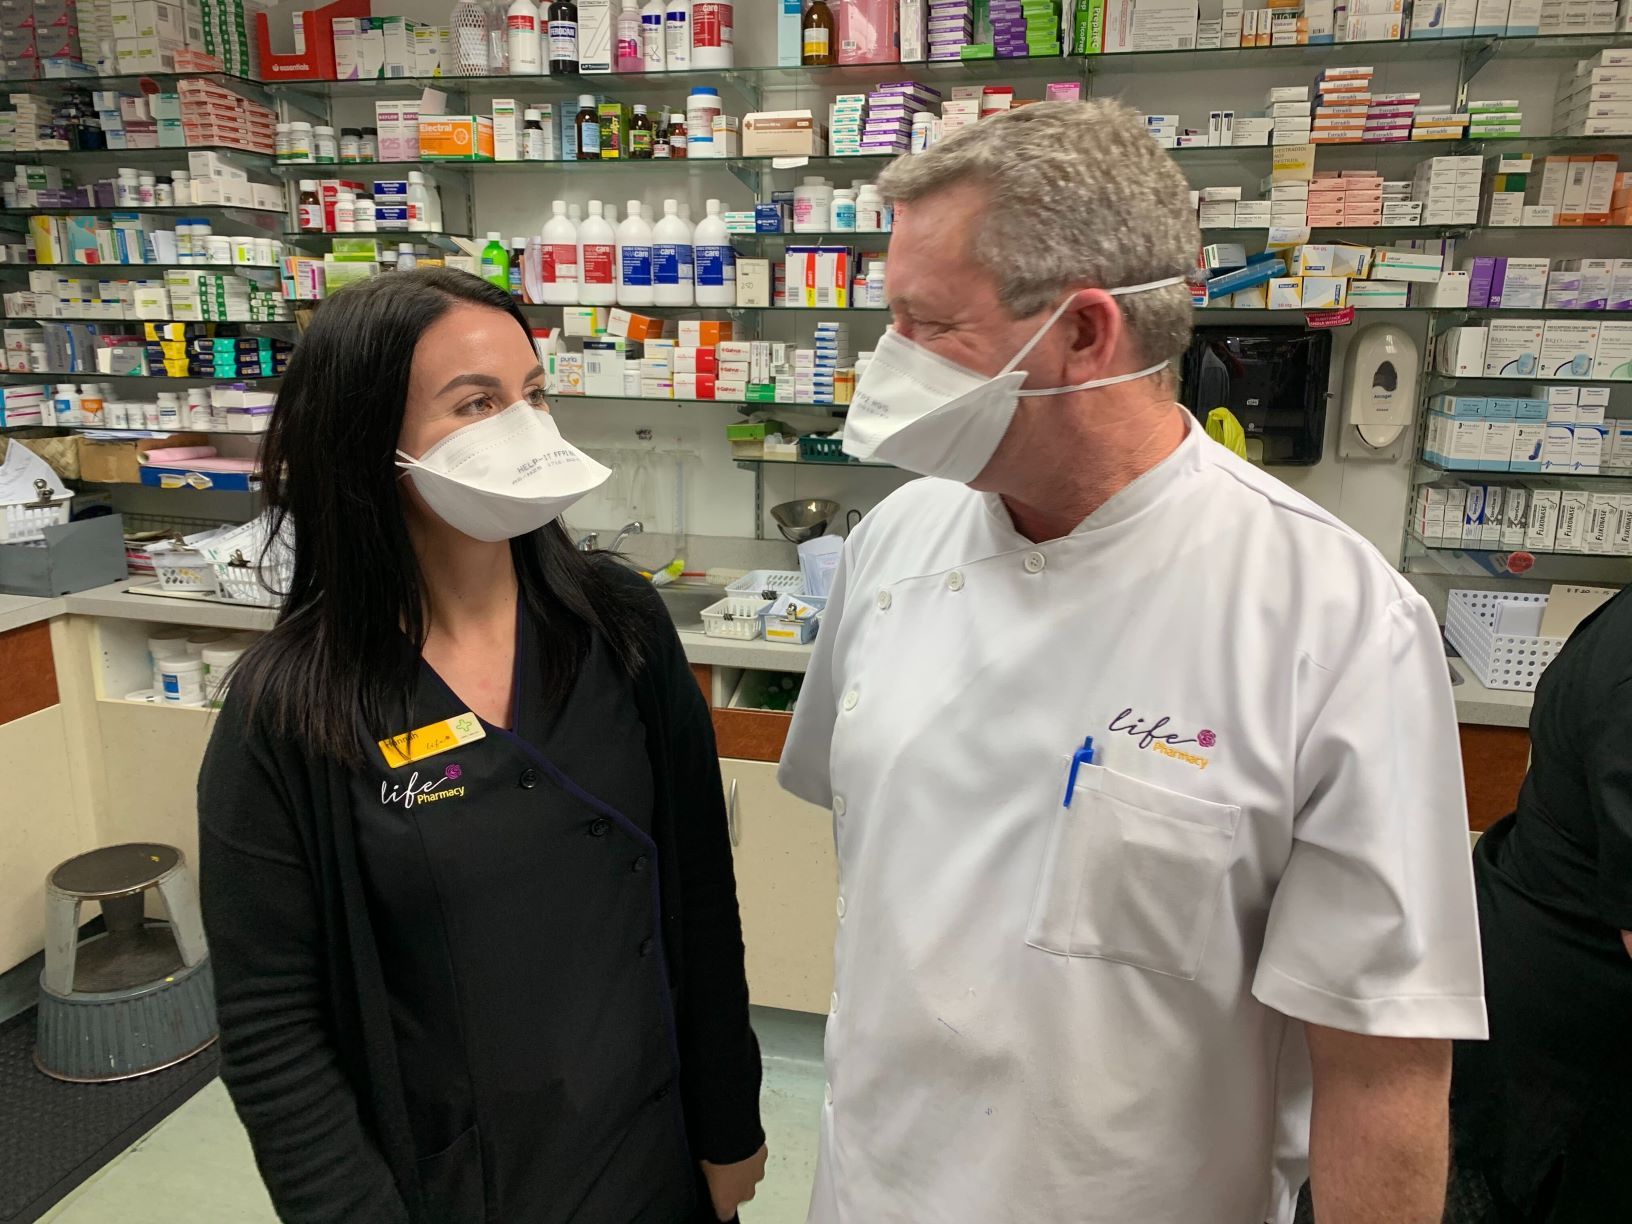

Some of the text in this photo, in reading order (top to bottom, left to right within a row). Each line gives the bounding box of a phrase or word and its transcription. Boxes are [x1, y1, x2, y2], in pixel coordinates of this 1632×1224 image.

[380, 138, 400, 149] 125
[1536, 505, 1547, 536] FLIXONASE
[1564, 506, 1576, 537] FLIXONASE
[1595, 510, 1607, 541] FLIXONASE
[1621, 511, 1632, 542] FLIXONASE
[386, 733, 418, 749] Hnnh
[381, 771, 449, 809] life
[417, 786, 466, 805] Pharmacy
